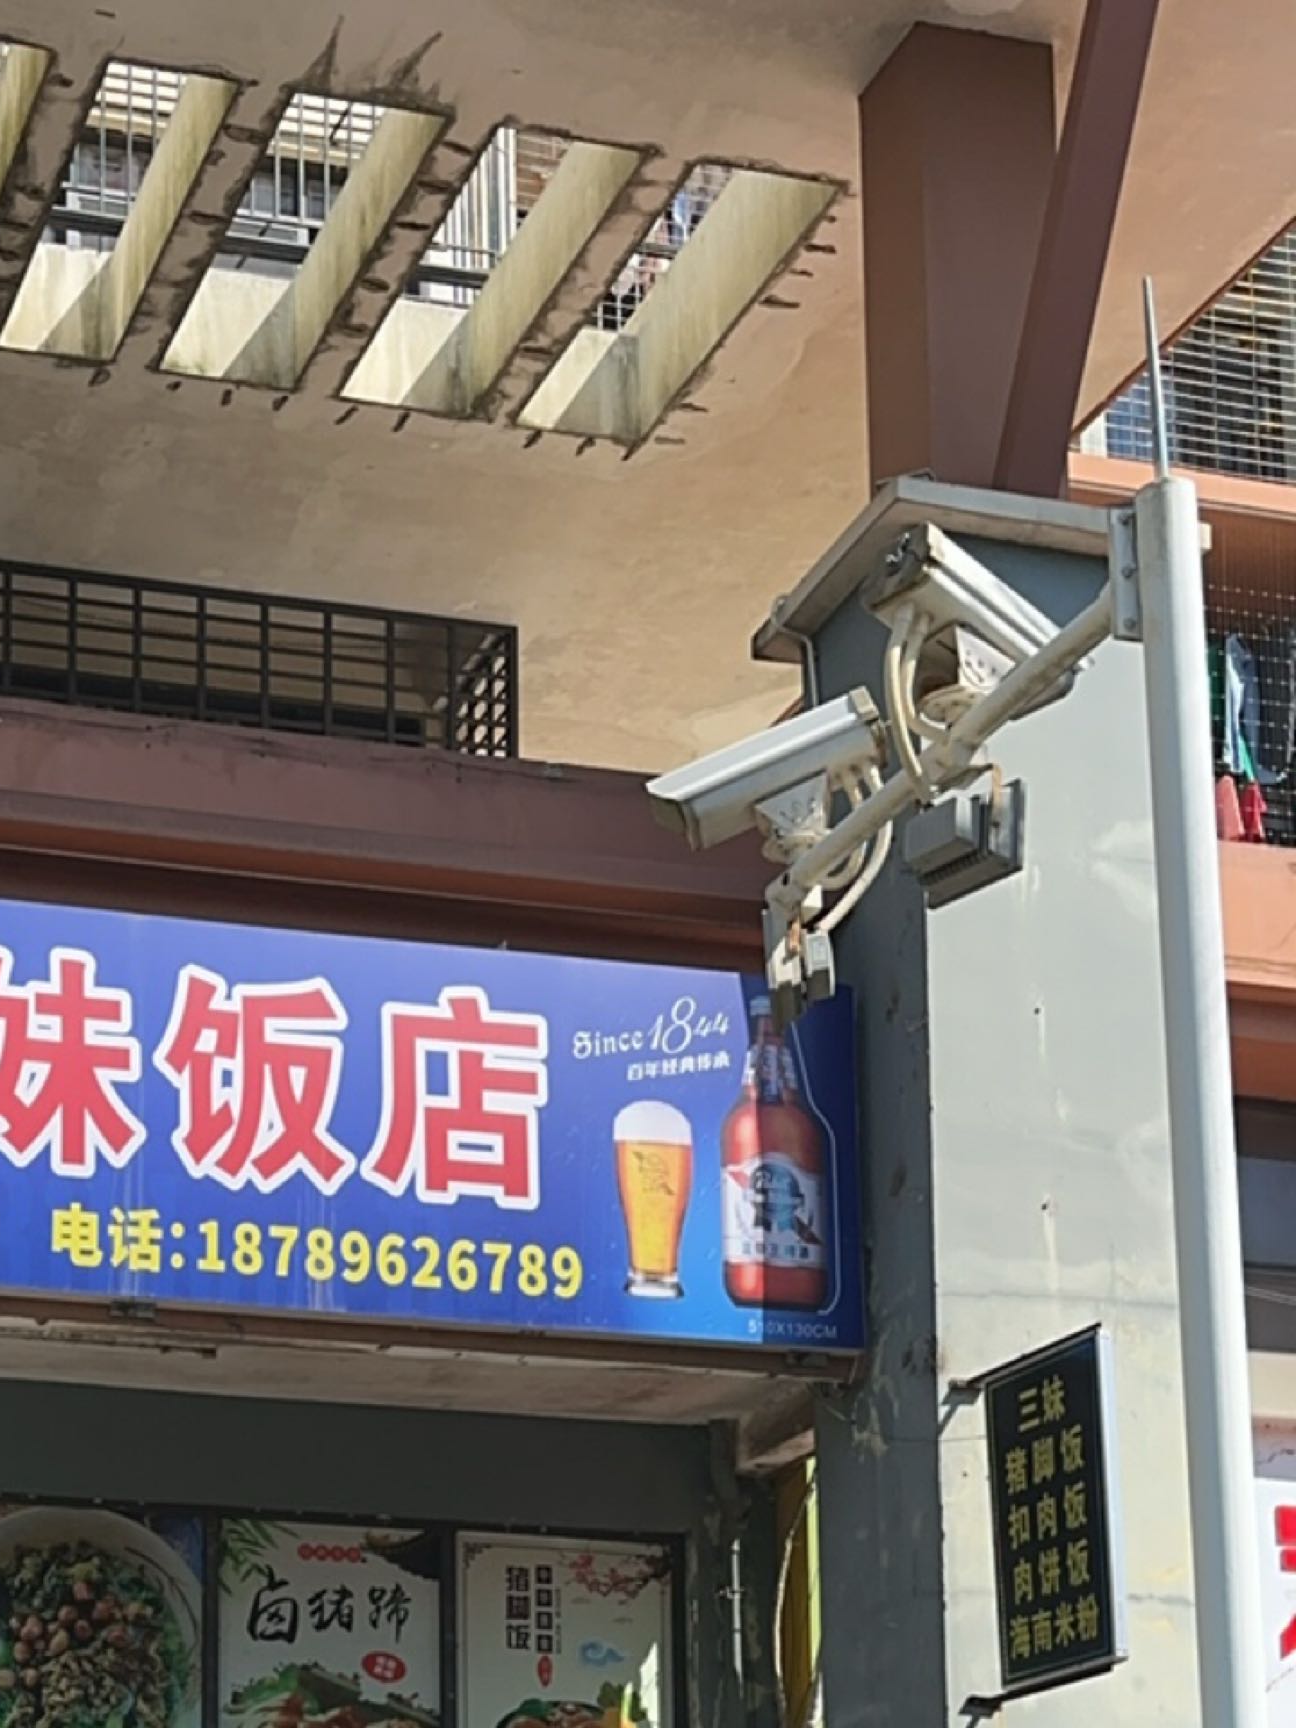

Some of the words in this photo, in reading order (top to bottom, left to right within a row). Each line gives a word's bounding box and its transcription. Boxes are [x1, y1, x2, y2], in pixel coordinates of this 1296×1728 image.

[573, 1031, 643, 1059] Since
[648, 996, 729, 1053] 1844
[51, 1201, 583, 1299] 电话:18789626789
[1017, 1374, 1065, 1433] 三妹
[1005, 1425, 1086, 1496] 猪脚饭
[1008, 1482, 1088, 1550] 扣肉饭
[247, 1566, 411, 1645] 卤猪蹄
[1013, 1539, 1090, 1605] 肉饼饭
[1009, 1593, 1100, 1660] 海南米粉
